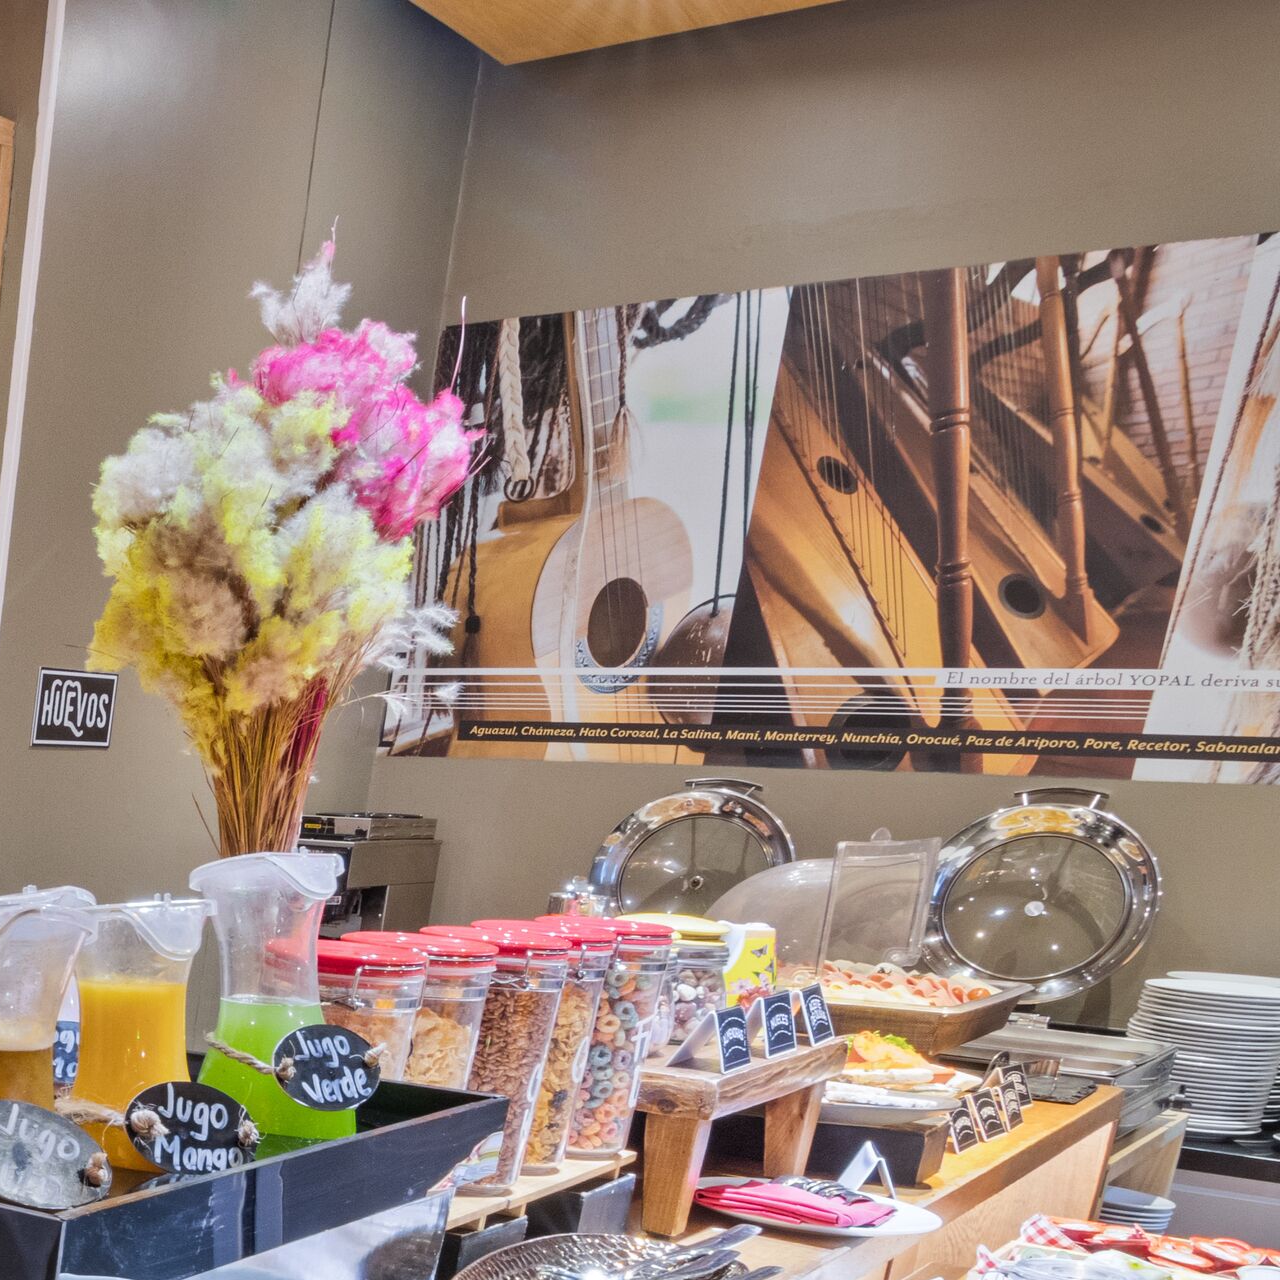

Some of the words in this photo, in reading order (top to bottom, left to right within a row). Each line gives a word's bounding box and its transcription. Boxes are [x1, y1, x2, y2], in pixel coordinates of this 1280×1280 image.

[946, 672, 963, 684] El
[969, 672, 1036, 686] nombre
[1043, 672, 1069, 686] del
[1075, 673, 1122, 686] árbol
[1129, 674, 1195, 688] YOPAL
[1201, 674, 1259, 688] deriva
[41, 678, 108, 737] HUEVOS
[470, 725, 518, 736] Aguazul,
[521, 725, 577, 738] Chámeza,
[579, 726, 608, 738] Hato
[610, 727, 660, 740] Corozal,
[663, 728, 678, 738] La
[680, 729, 722, 741] Salina,
[726, 730, 762, 742] Maní,
[764, 730, 838, 744] Monterrey,
[841, 732, 903, 745] Nunchía,
[906, 733, 962, 747] Orocué,
[965, 736, 992, 746] Paz
[995, 736, 1013, 747] de
[1015, 736, 1080, 750] Ariporo,
[1083, 738, 1123, 750] Pore,
[1127, 739, 1191, 753] Recetor,
[294, 1030, 350, 1068] Jugo
[302, 1066, 372, 1104] Verde
[158, 1082, 228, 1141] Jugo
[154, 1134, 244, 1174] Mango
